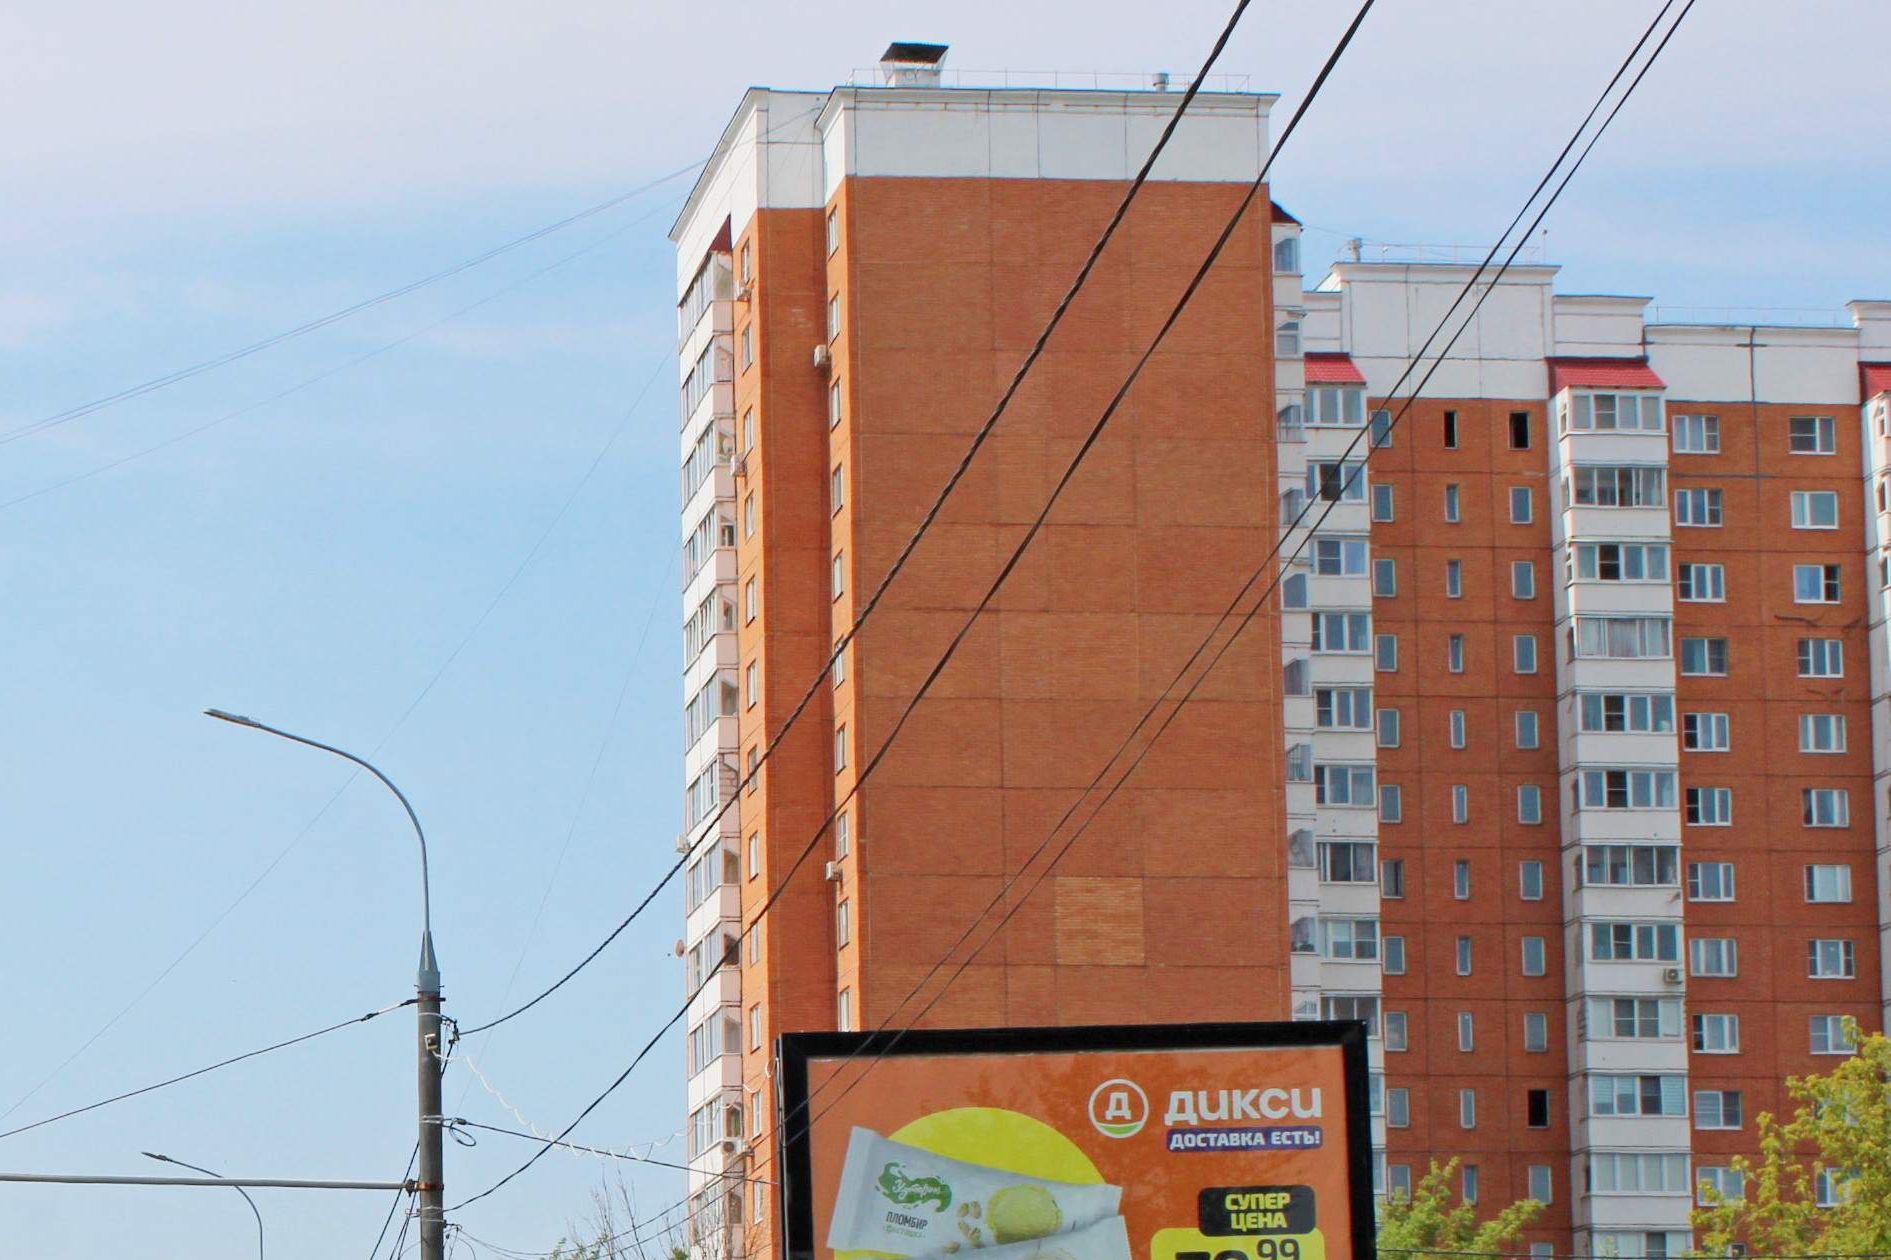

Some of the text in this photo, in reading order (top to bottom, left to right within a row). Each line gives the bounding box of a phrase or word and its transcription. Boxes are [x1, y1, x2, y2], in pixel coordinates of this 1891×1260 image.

[1164, 1087, 1323, 1127] ДИКСИ
[1169, 1130, 1321, 1150] ДОСТАВКА ЕСТЬ!
[1224, 1192, 1291, 1211] СУПЕР
[885, 1210, 929, 1230] ПЛОМБИР
[1230, 1211, 1288, 1232] ЦЕНА
